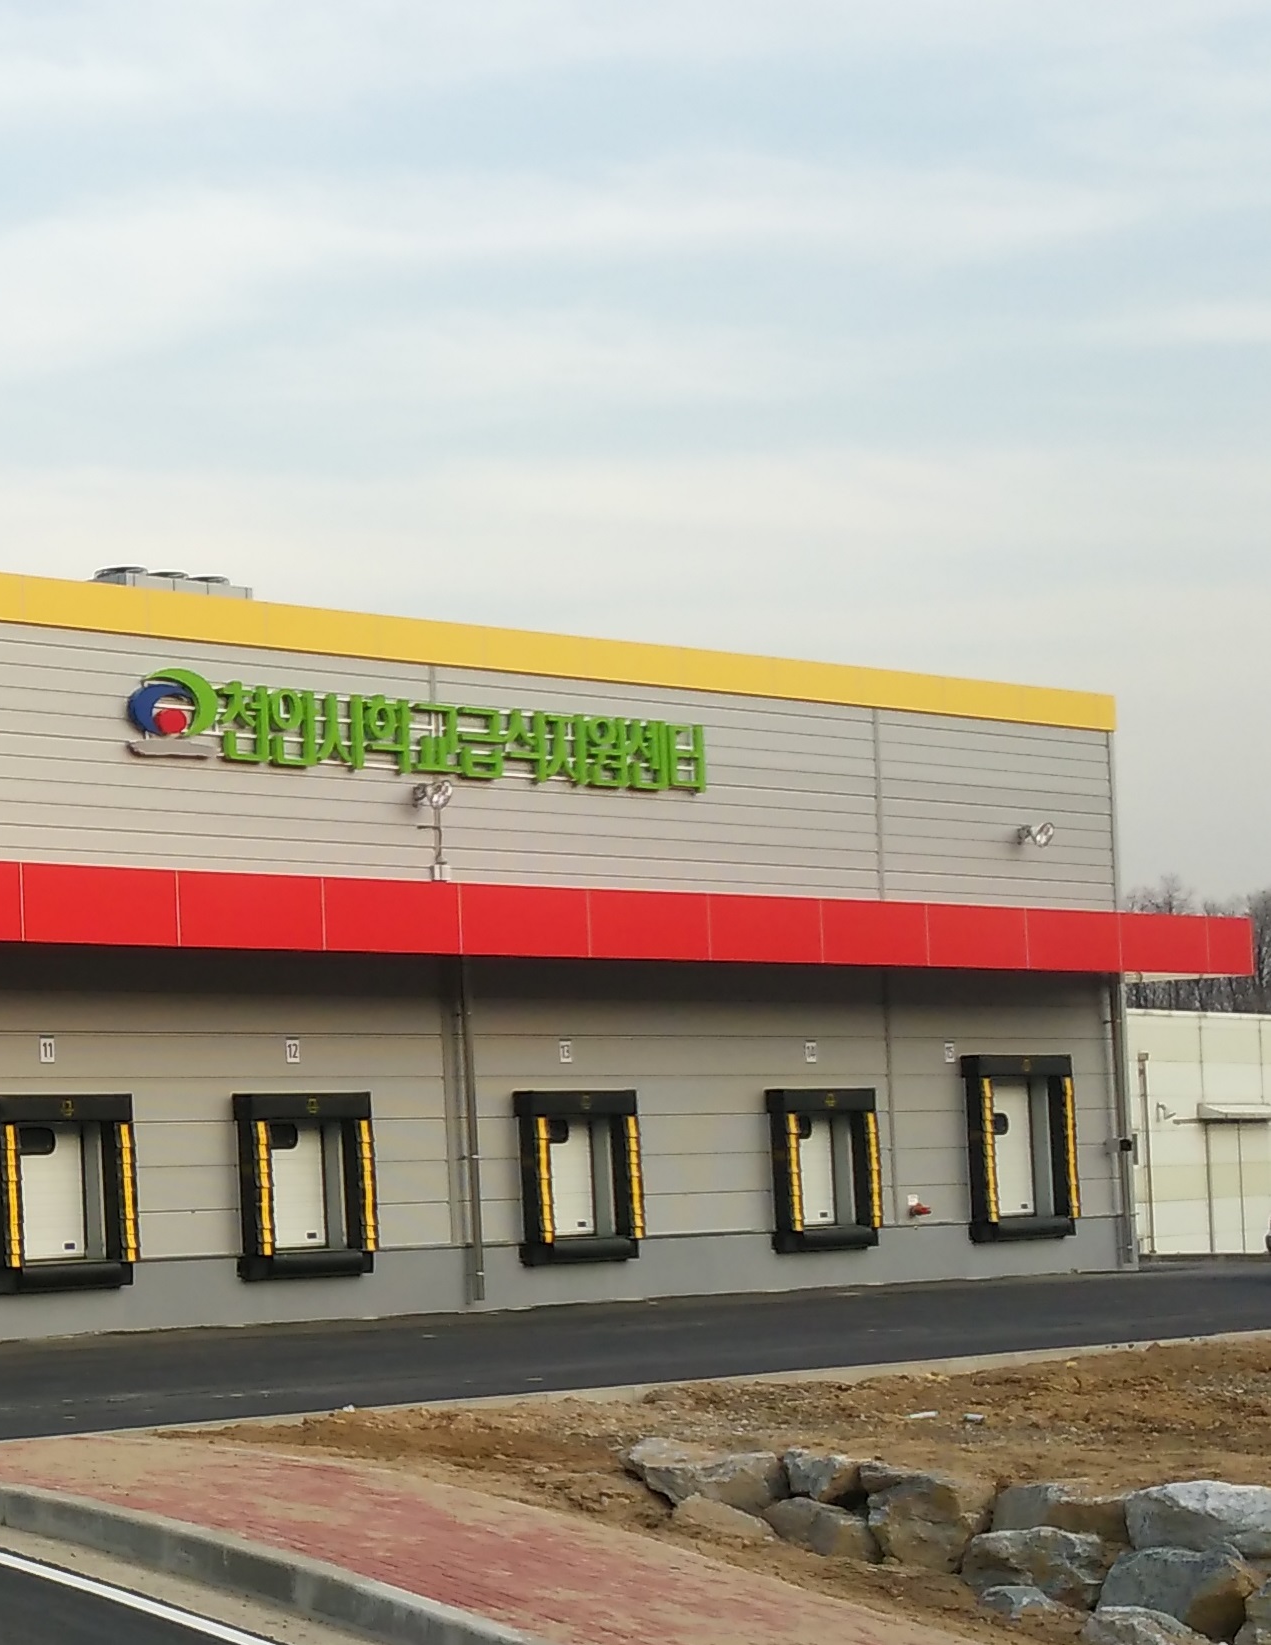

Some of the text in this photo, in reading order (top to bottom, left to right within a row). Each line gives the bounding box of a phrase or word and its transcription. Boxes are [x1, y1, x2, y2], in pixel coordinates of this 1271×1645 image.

[219, 680, 707, 794] 천안시학교급식지원센터
[42, 1041, 53, 1058] 11
[287, 1043, 299, 1059] 12
